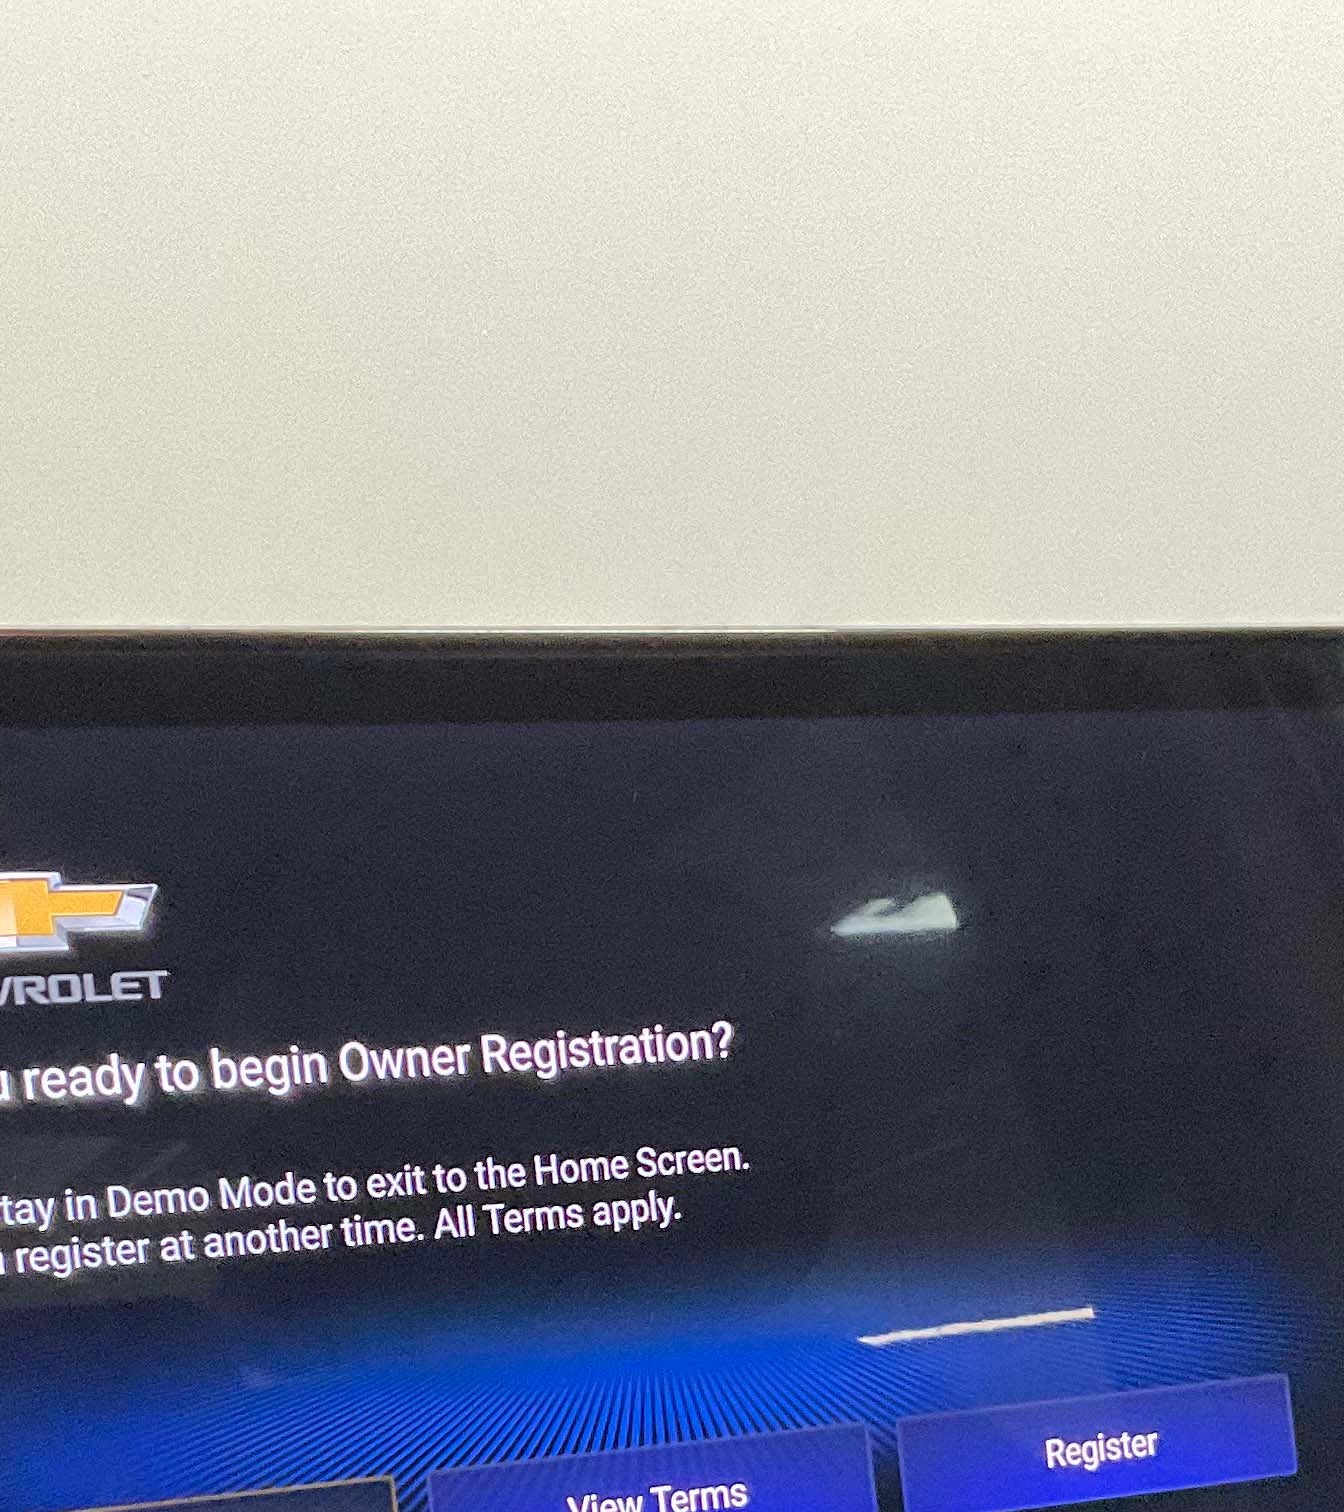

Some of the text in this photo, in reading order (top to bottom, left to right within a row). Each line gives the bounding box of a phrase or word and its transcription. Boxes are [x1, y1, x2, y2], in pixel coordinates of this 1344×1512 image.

[22, 1052, 146, 1106] ready
[158, 1056, 201, 1092] to
[211, 1045, 329, 1098] begin
[339, 1036, 472, 1083] Owner
[481, 1020, 735, 1080] Registration?
[65, 1186, 99, 1220] in
[108, 1182, 210, 1216] Demo
[219, 1174, 317, 1208] Mode
[325, 1171, 357, 1201] to
[366, 1164, 426, 1198] exit
[434, 1162, 466, 1193] to
[474, 1155, 526, 1189] the
[533, 1148, 628, 1186] Home
[637, 1142, 751, 1177] Screen.
[15, 1236, 150, 1282] register
[160, 1235, 196, 1264] at
[204, 1220, 334, 1260] another
[342, 1211, 424, 1246] time.
[434, 1206, 475, 1241] All
[485, 1199, 585, 1235] Terms
[593, 1189, 682, 1235] apply.
[1044, 1427, 1160, 1472] Register
